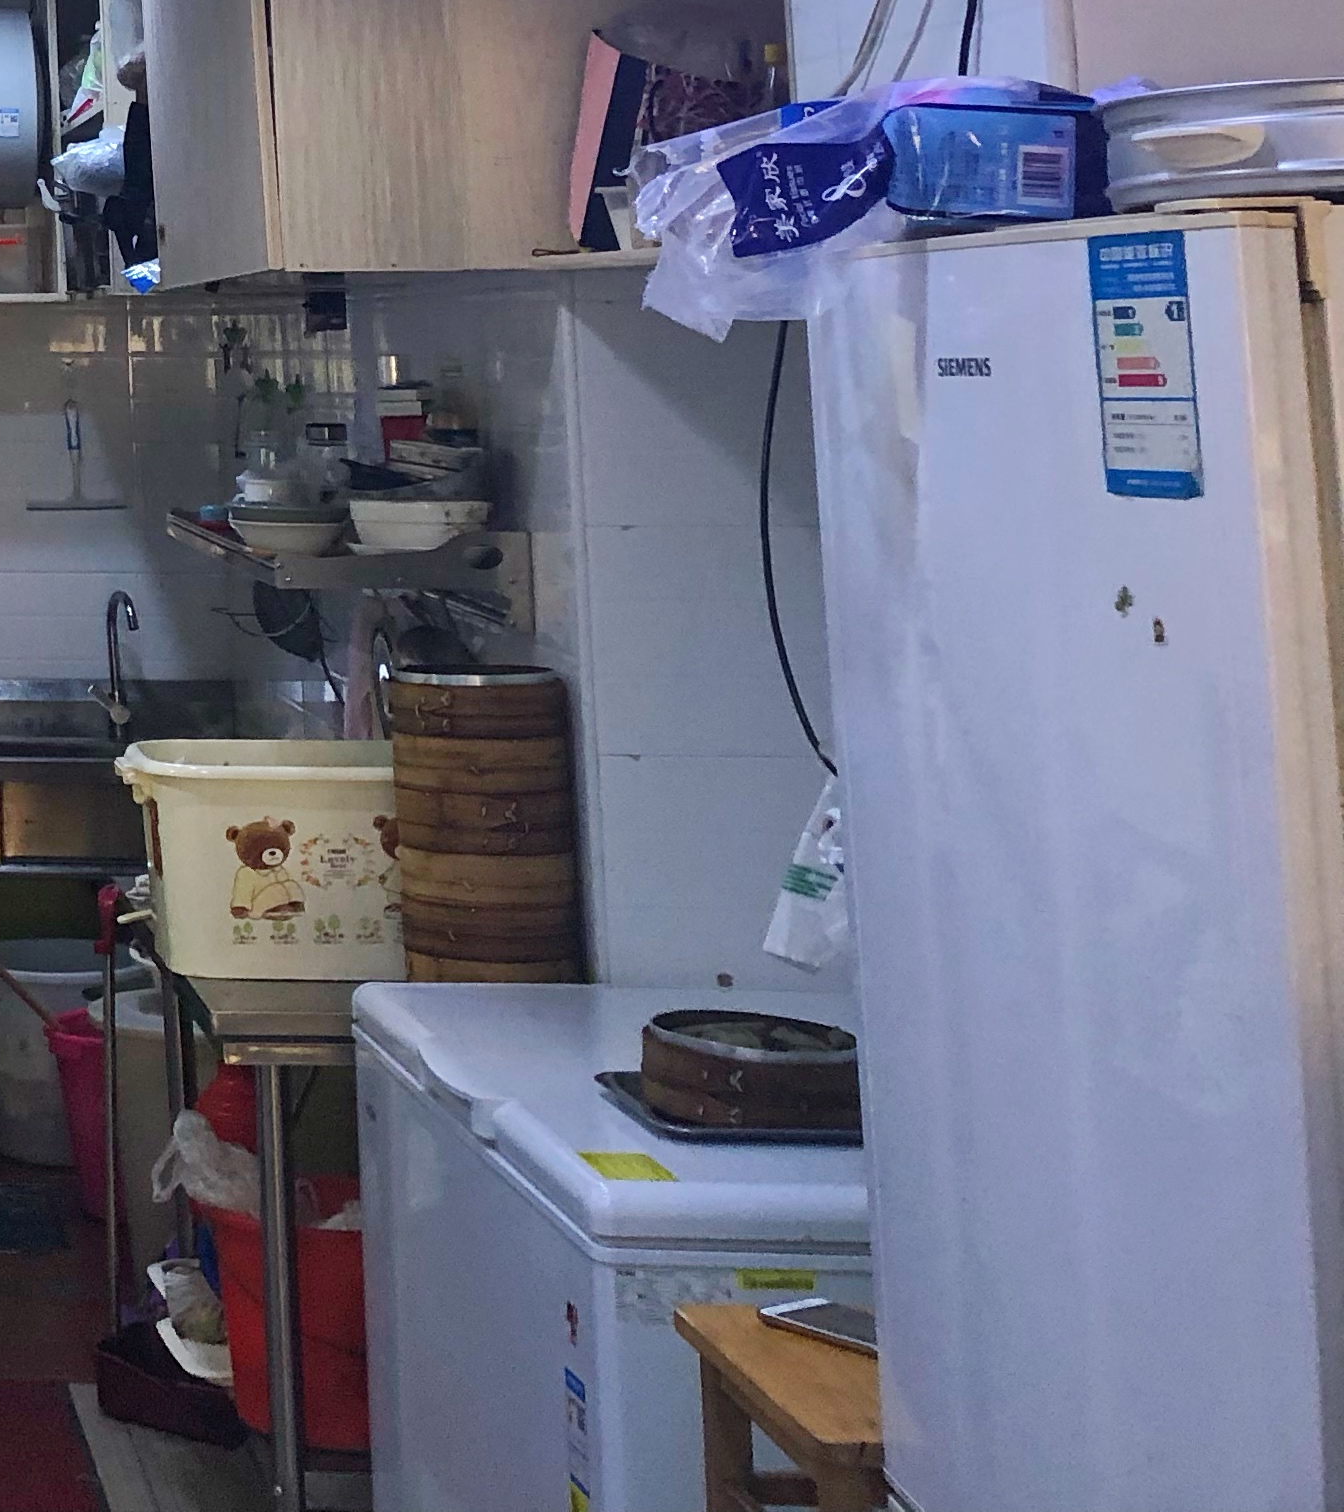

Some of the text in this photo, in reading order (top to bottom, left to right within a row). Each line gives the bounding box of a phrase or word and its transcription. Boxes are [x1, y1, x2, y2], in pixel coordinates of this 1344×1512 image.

[761, 152, 800, 243] 美家欣
[937, 357, 992, 377] SIEMENS
